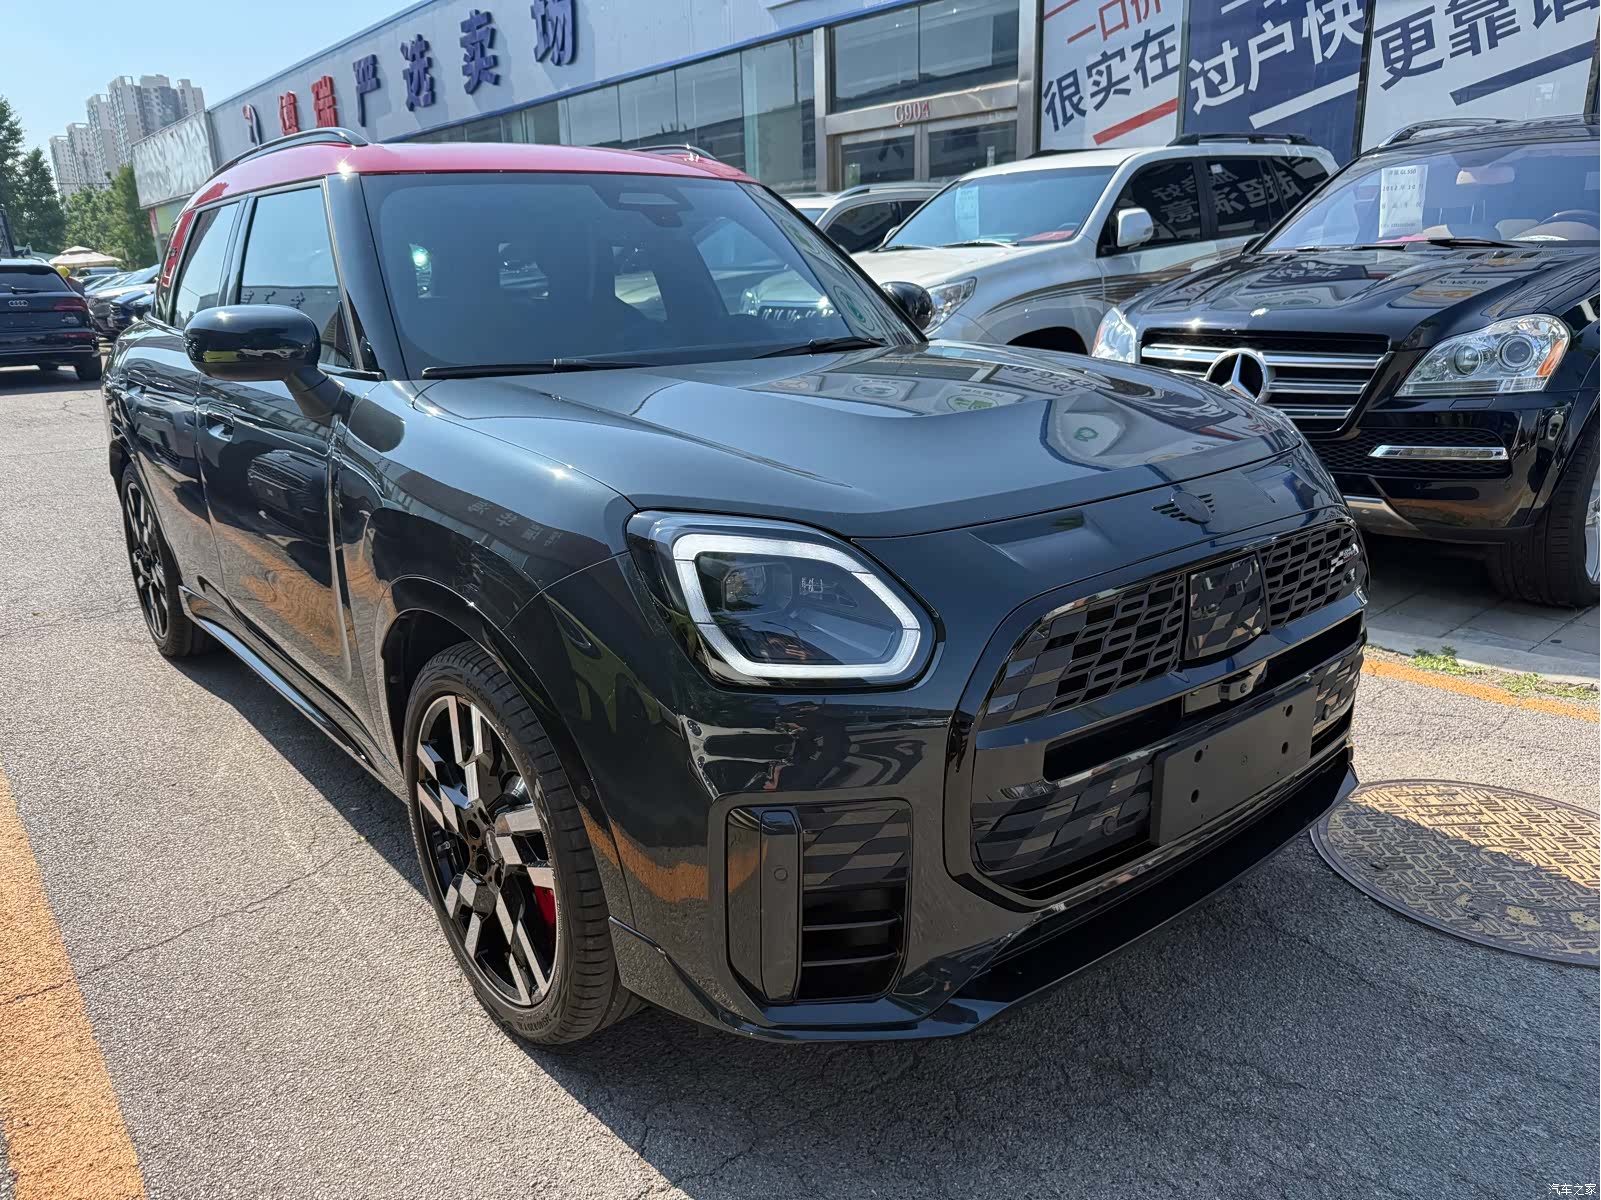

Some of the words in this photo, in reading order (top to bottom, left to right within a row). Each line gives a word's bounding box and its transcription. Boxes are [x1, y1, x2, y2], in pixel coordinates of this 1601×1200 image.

[1043, 24, 1180, 132] 很实在
[1188, 0, 1364, 115] 过户快
